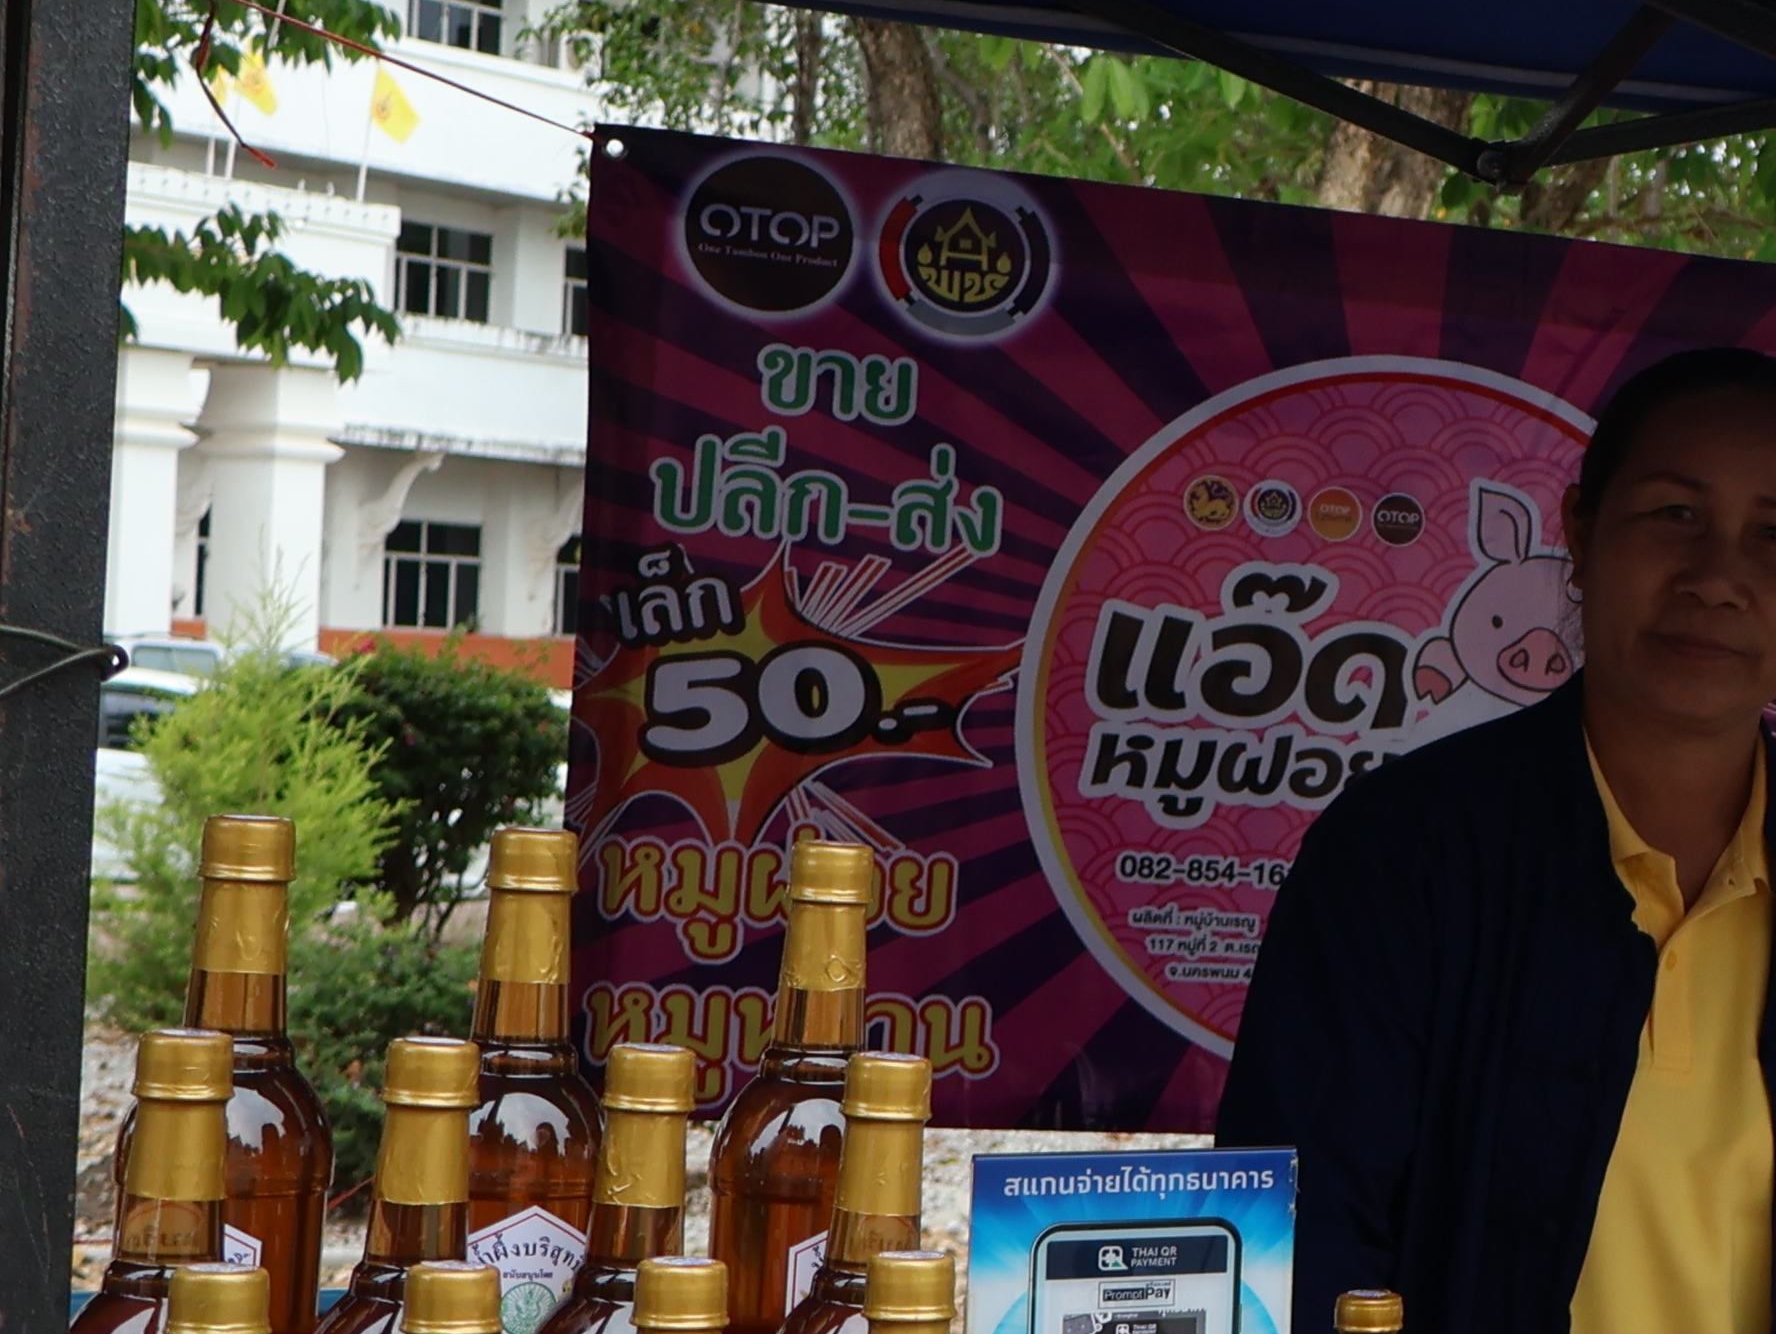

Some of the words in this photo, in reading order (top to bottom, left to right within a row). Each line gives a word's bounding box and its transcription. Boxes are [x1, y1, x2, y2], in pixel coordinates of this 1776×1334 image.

[700, 203, 841, 248] OTOP
[698, 242, 720, 256] One
[724, 245, 768, 260] Tambon
[771, 249, 792, 263] One
[796, 252, 839, 267] Product
[759, 343, 916, 425] ขาย
[650, 427, 1003, 555] ปลีก-ส่ง
[1377, 511, 1420, 523] OTOP
[612, 545, 740, 645] เล็ก
[1093, 567, 1412, 733] แอ๊ด
[1120, 855, 1291, 886] 082-854-16
[600, 820, 957, 963] หมูฝย
[1150, 938, 1173, 951] 117
[1209, 941, 1218, 953] 2
[1004, 1167, 1275, 1200] สแกนจ่ายได้ทุกธนาคาร
[1130, 1257, 1178, 1267] PAYMENT
[1132, 1247, 1158, 1257] THAI
[1161, 1246, 1178, 1256] QR
